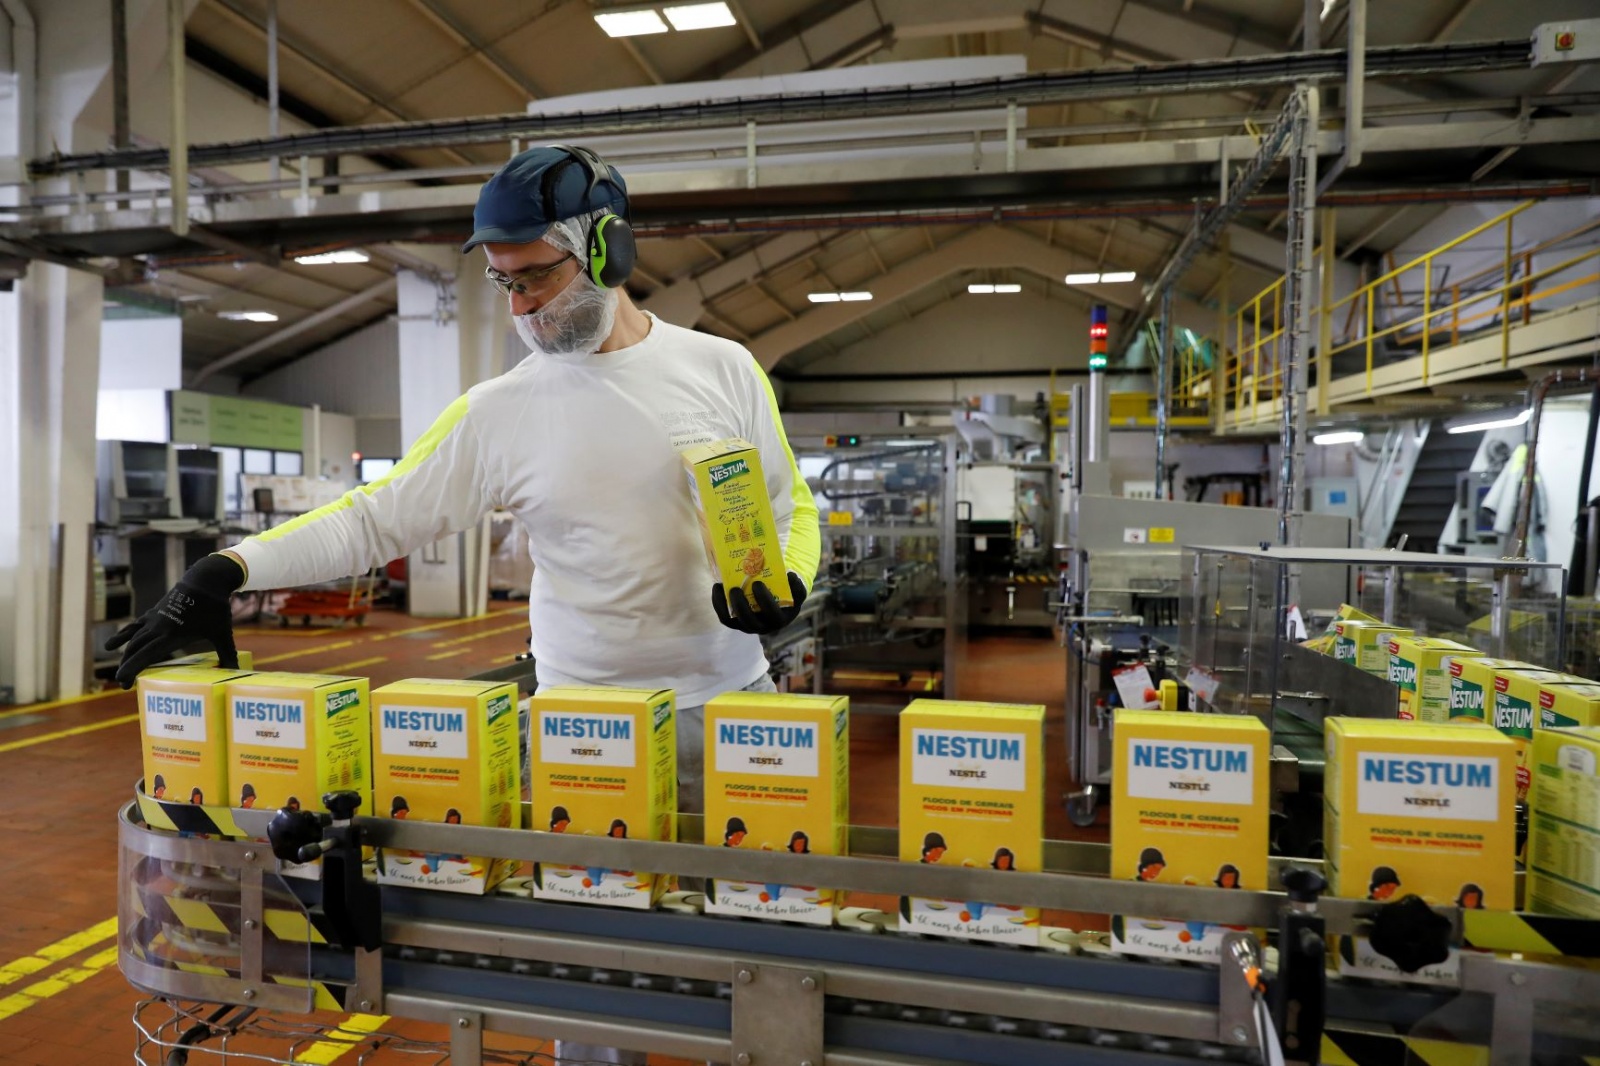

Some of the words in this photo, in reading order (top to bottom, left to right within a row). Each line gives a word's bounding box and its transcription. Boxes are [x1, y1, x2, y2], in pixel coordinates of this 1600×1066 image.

[710, 462, 748, 483] NESTUM
[1335, 644, 1356, 660] NESTUM
[1389, 662, 1416, 683] NESTUM
[148, 696, 202, 717] NESTUM
[326, 690, 358, 712] NESTUM
[1449, 688, 1485, 709] NESTUM
[236, 701, 301, 723] NESTUM
[385, 711, 463, 732] NESTUM
[1494, 704, 1534, 729] NESTUM
[545, 717, 630, 739] NESTUM
[721, 724, 813, 748] NESTUM
[918, 735, 1020, 760] NESTUM
[1134, 745, 1247, 773] NESTUM
[1364, 759, 1491, 787] NESTUM
[923, 796, 957, 805] FLOCOS
[1140, 810, 1177, 819] FLOCOS
[1198, 814, 1240, 822] CEREAIS
[1370, 828, 1413, 837] FLOCOS
[1436, 832, 1484, 841] CEREAIS
